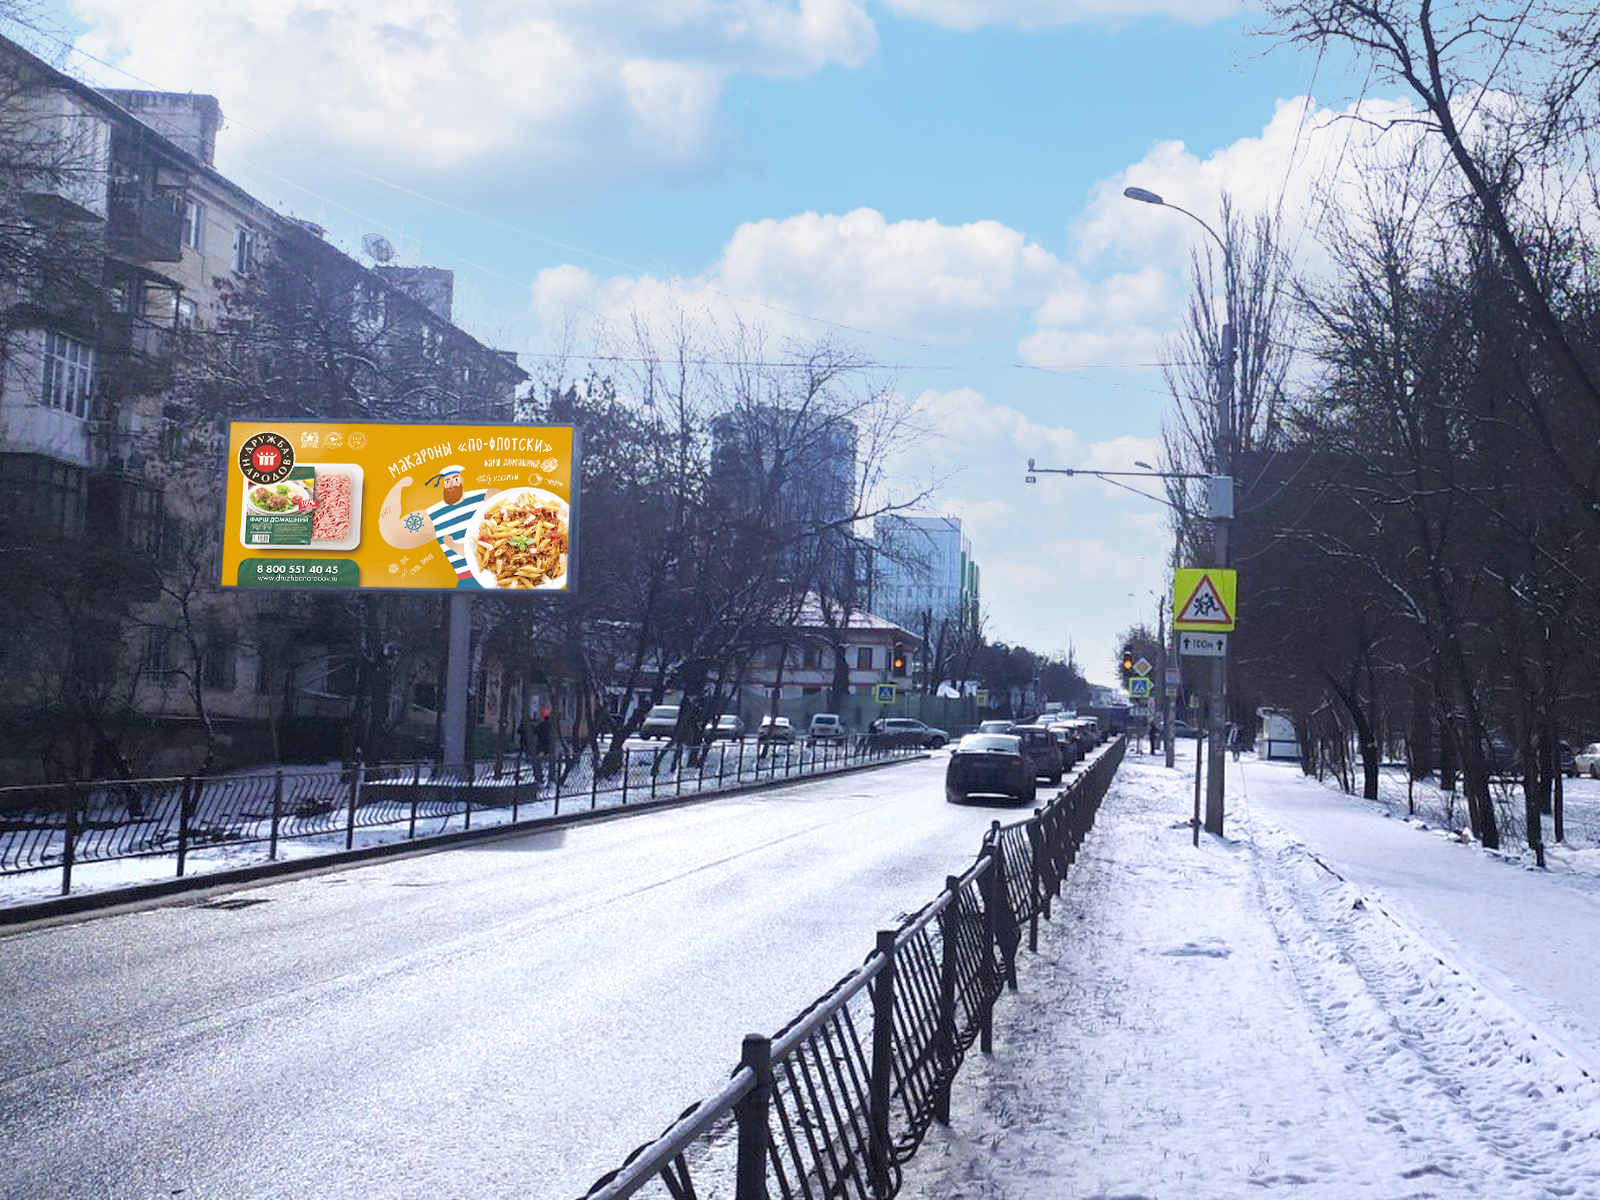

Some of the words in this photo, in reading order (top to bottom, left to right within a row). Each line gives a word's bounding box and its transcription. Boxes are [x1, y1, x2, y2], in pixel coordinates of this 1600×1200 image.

[244, 435, 290, 456] ДРУЖБА
[242, 458, 291, 483] НАРОДОВ
[270, 515, 309, 523] ДОМАШНИЙ
[256, 565, 264, 574] 8
[265, 565, 286, 574] 800
[288, 565, 305, 574] 551
[308, 565, 323, 574] 40
[324, 565, 339, 574] 45
